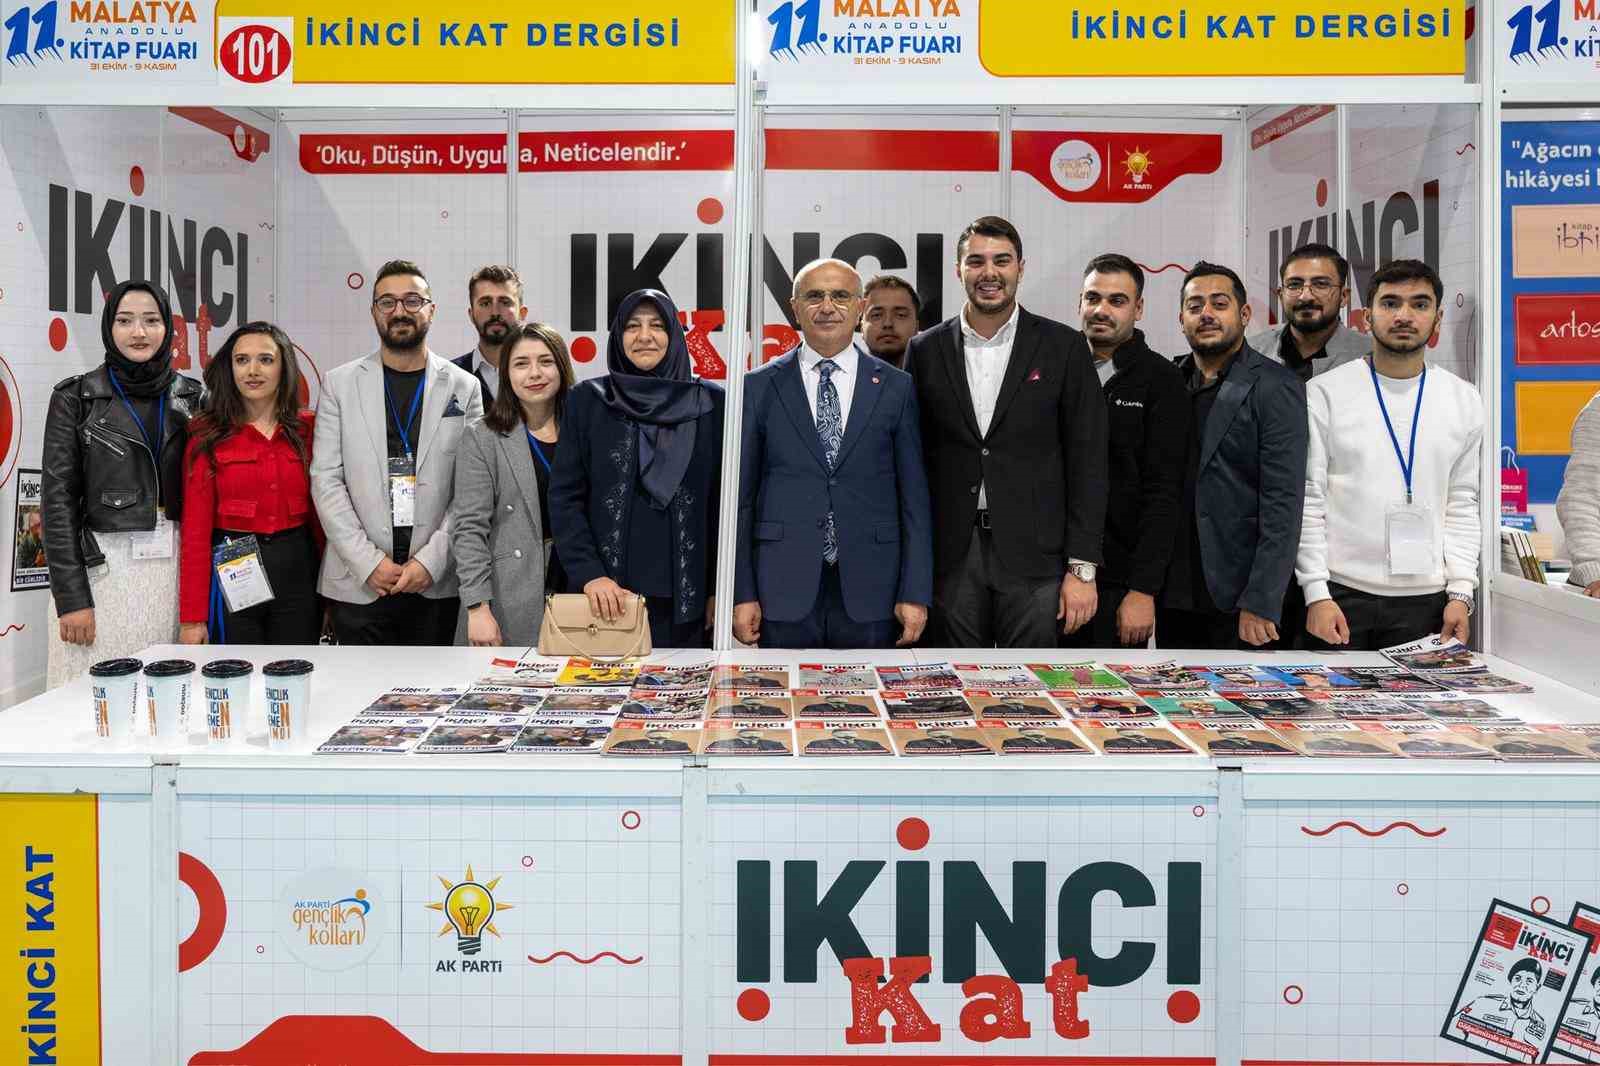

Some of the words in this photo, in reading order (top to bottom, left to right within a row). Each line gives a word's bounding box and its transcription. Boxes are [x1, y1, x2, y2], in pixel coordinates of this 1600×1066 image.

[70, 0, 196, 23] MALATYA
[833, 0, 961, 17] MALATYA
[85, 27, 184, 35] ANADOLU
[306, 17, 420, 46] İKİNCİ
[440, 23, 508, 46] KAT
[526, 17, 680, 47] DERGİSİ
[1071, 10, 1187, 39] İKİNCİ
[1207, 15, 1276, 38] KAT
[1295, 8, 1450, 38] DERGİSİ
[70, 38, 130, 59] KİTAP
[136, 42, 197, 59] FUARI
[232, 31, 280, 76] 101
[833, 32, 894, 53] KİTAP
[900, 36, 961, 53] FUARI
[102, 62, 127, 71] EKİM
[866, 57, 891, 65] EKİM
[908, 57, 942, 65] KASIM
[372, 144, 443, 168] Düşün,
[1505, 169, 1591, 192] hikâyesi
[25, 845, 55, 931] KAT
[293, 903, 347, 931] gençlik
[435, 960, 457, 973] AK
[843, 955, 1090, 1045] Kat
